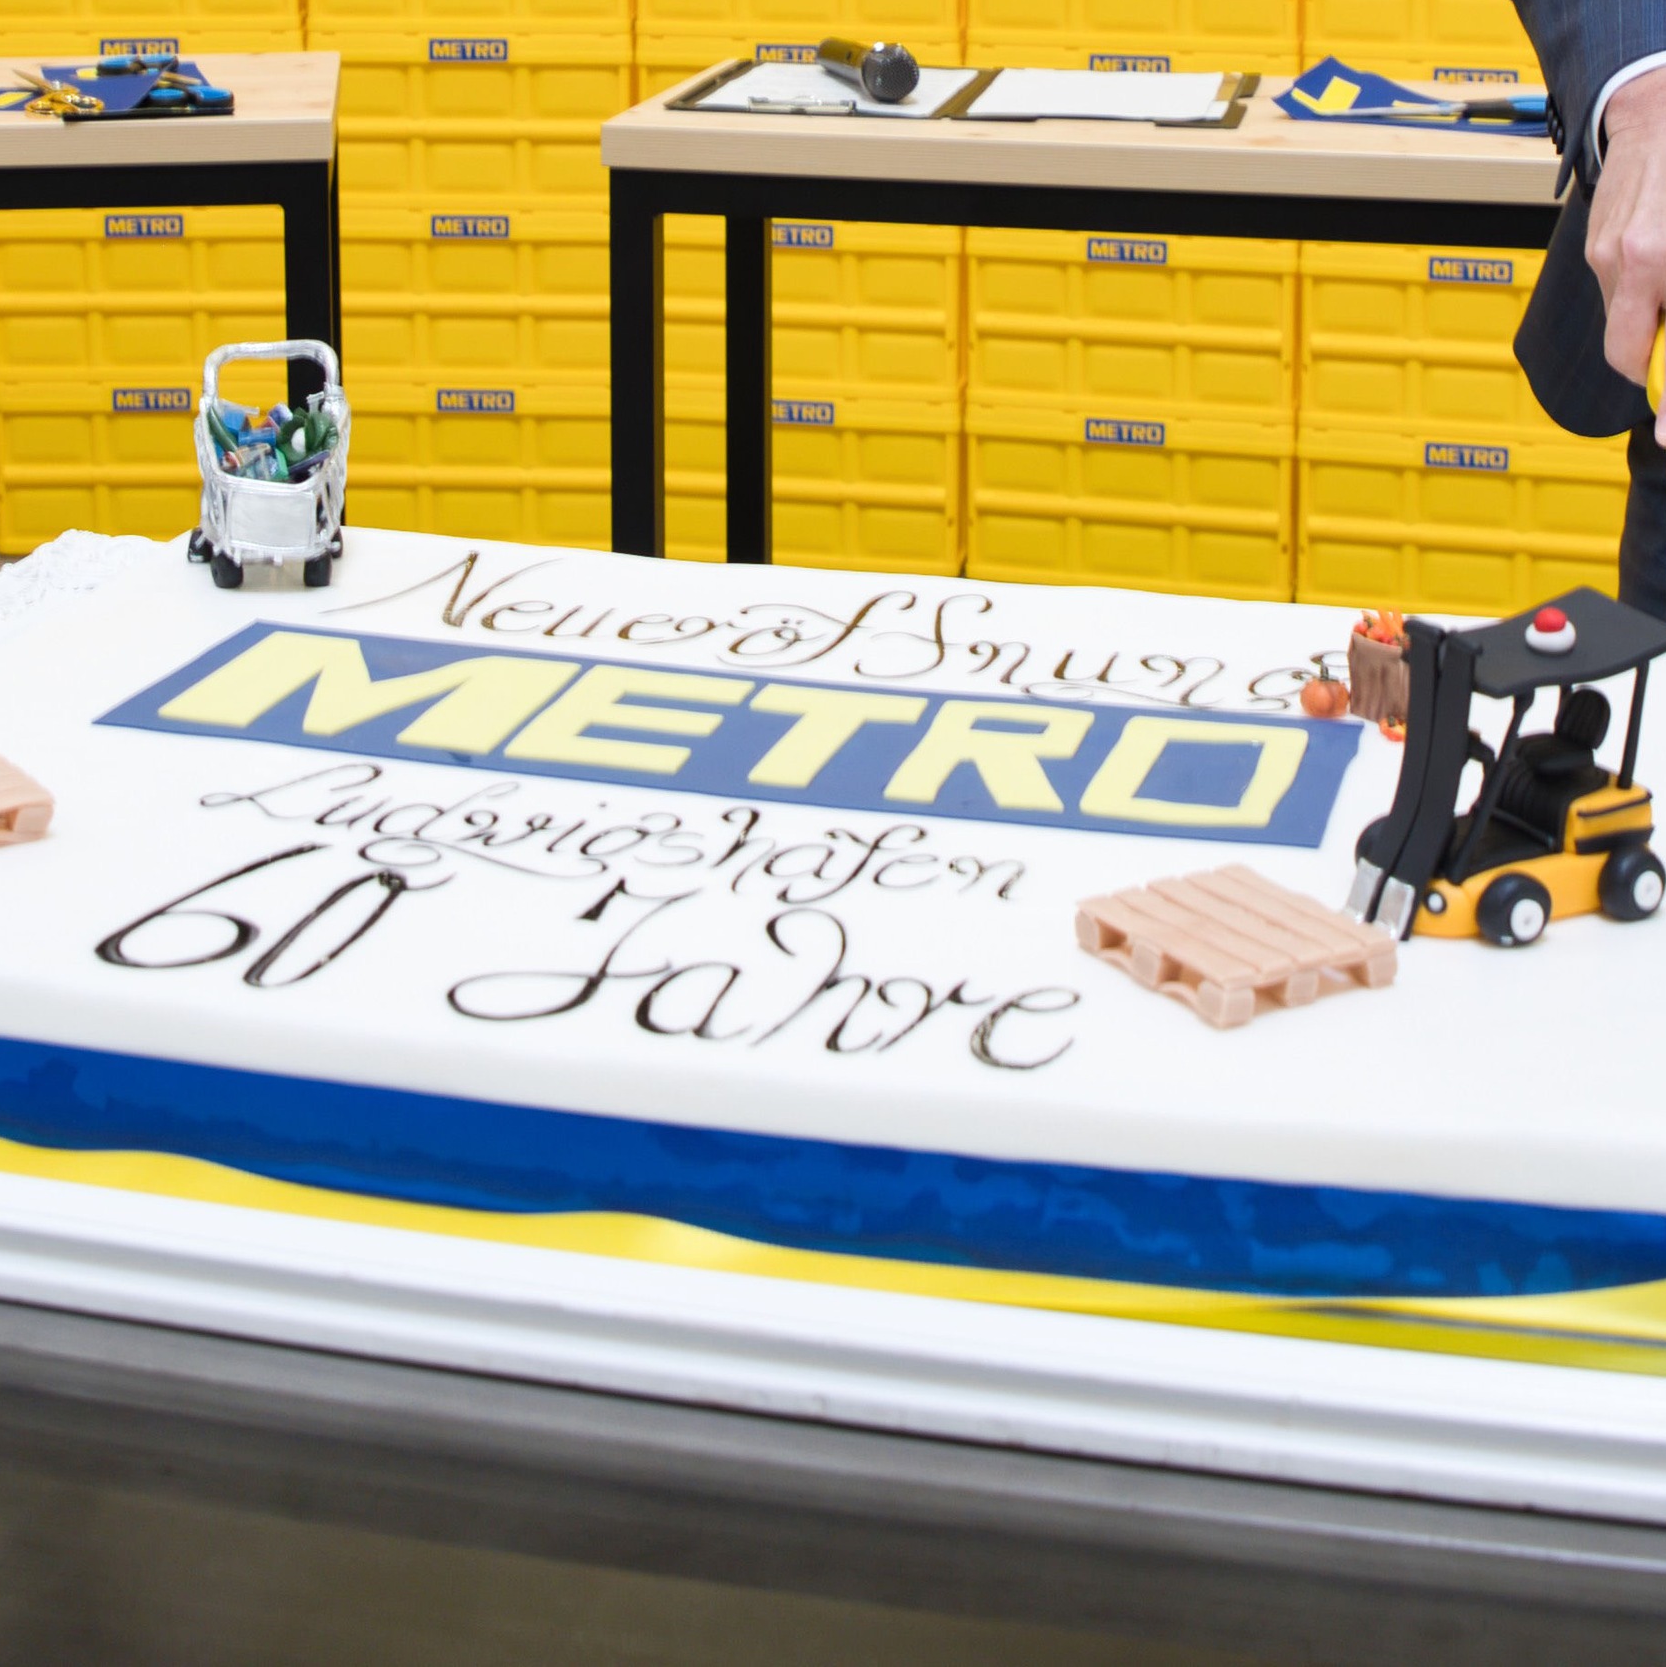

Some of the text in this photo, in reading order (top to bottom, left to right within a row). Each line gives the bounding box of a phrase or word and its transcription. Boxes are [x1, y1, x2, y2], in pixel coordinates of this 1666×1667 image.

[102, 41, 177, 56] METRO
[432, 42, 505, 58] METRO
[758, 47, 816, 62] METR
[1092, 57, 1166, 72] METRO
[108, 218, 180, 233] METRO
[434, 219, 507, 234] METRO
[1091, 242, 1164, 260] METRO
[1432, 261, 1510, 280] METRO
[116, 392, 188, 407] METRO
[440, 393, 511, 408] METRO
[1088, 422, 1162, 442] METRO
[1429, 447, 1505, 466] METRO
[158, 630, 1309, 828] METRO
[199, 764, 1026, 906] Ludwigshafen
[94, 843, 1082, 1070] 60 Jahre
